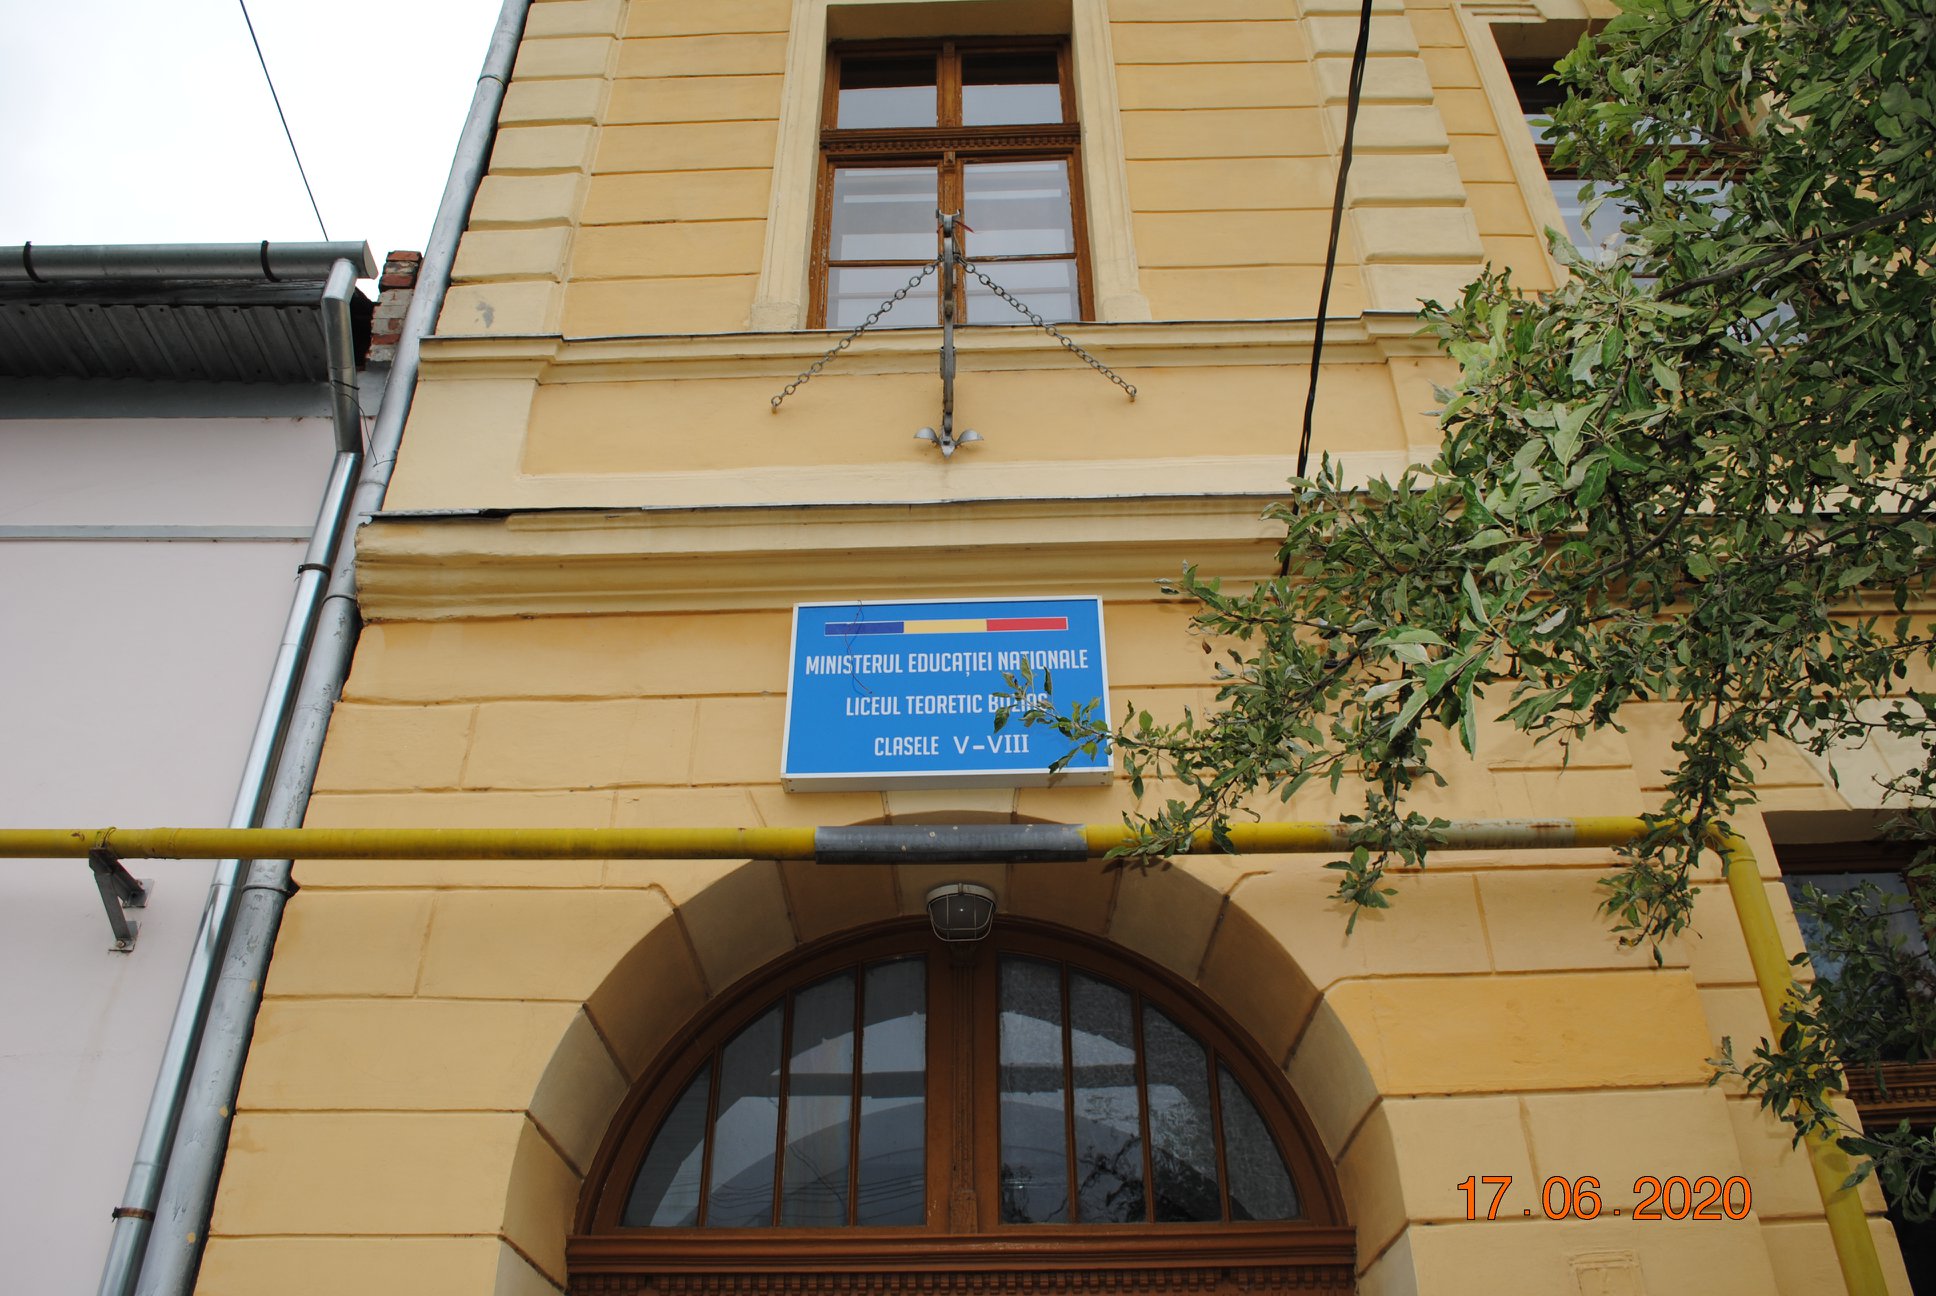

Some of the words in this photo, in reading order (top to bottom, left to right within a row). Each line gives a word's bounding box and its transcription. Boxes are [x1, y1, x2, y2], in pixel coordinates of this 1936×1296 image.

[805, 654, 903, 675] MINISTERUL
[908, 652, 992, 677] EDUCAȚIEI
[846, 696, 901, 716] LICEUL
[906, 694, 983, 714] TEORETIC
[874, 736, 939, 756] CLASELE
